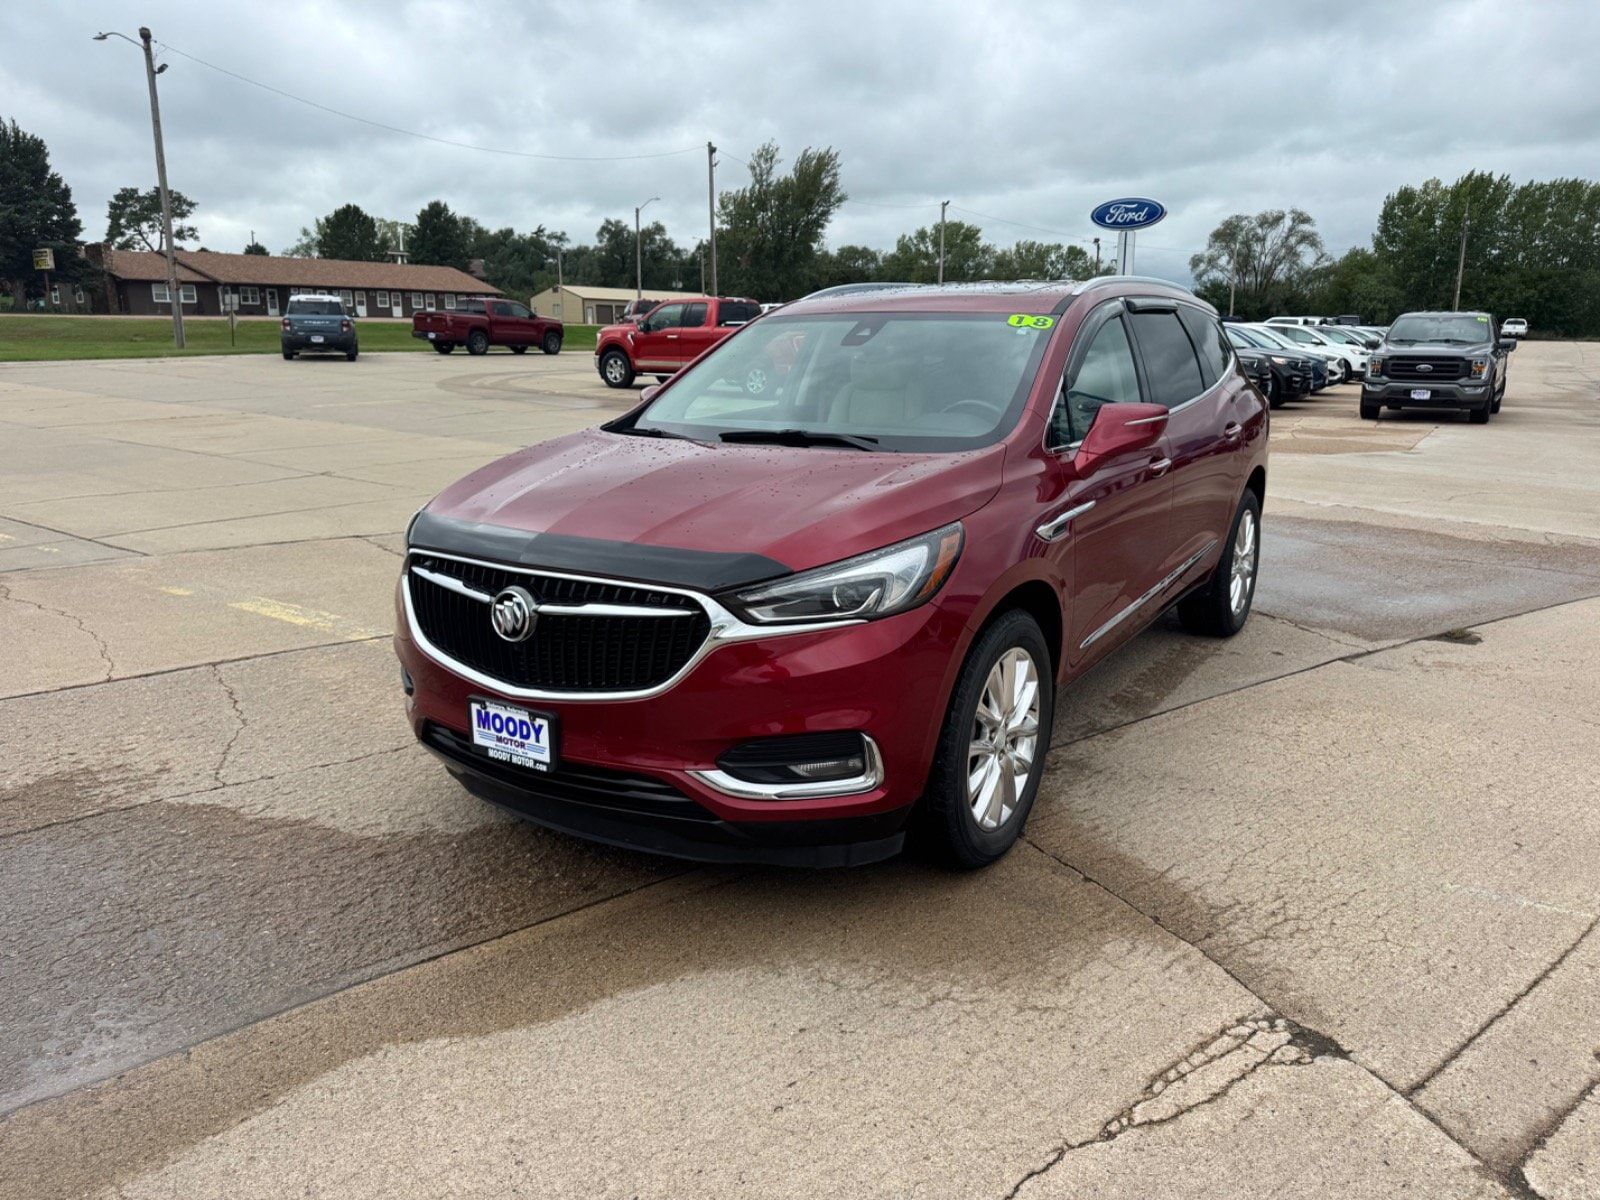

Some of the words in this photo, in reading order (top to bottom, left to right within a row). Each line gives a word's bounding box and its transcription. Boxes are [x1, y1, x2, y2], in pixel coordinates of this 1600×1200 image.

[1105, 203, 1149, 224] Ford
[1016, 314, 1049, 326] 18
[476, 709, 544, 744] MOODY
[495, 735, 527, 750] MOTOR
[488, 748, 511, 762] MOODY
